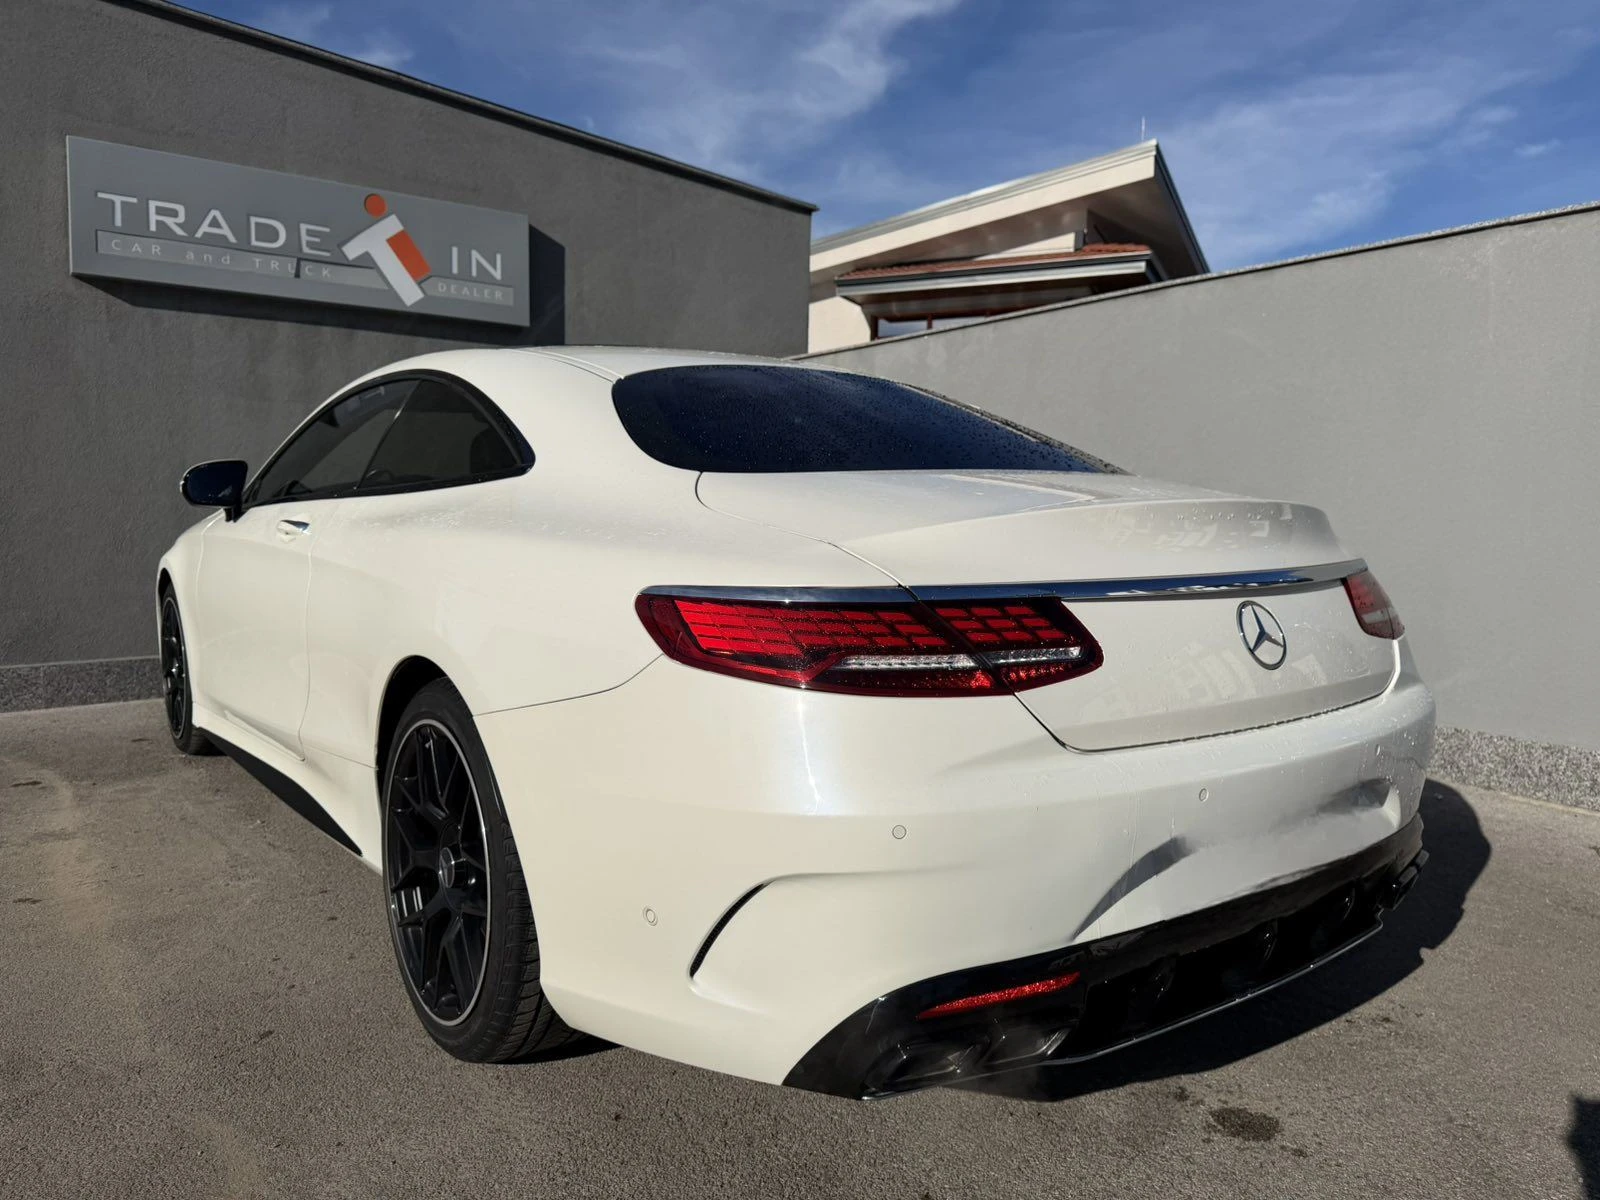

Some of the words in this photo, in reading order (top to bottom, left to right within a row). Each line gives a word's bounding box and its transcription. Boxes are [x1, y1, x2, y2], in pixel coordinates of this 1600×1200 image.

[97, 192, 331, 257] TRADE
[452, 246, 502, 281] IN
[111, 239, 161, 256] CAR
[186, 251, 231, 266] and
[438, 282, 504, 300] DEALER
